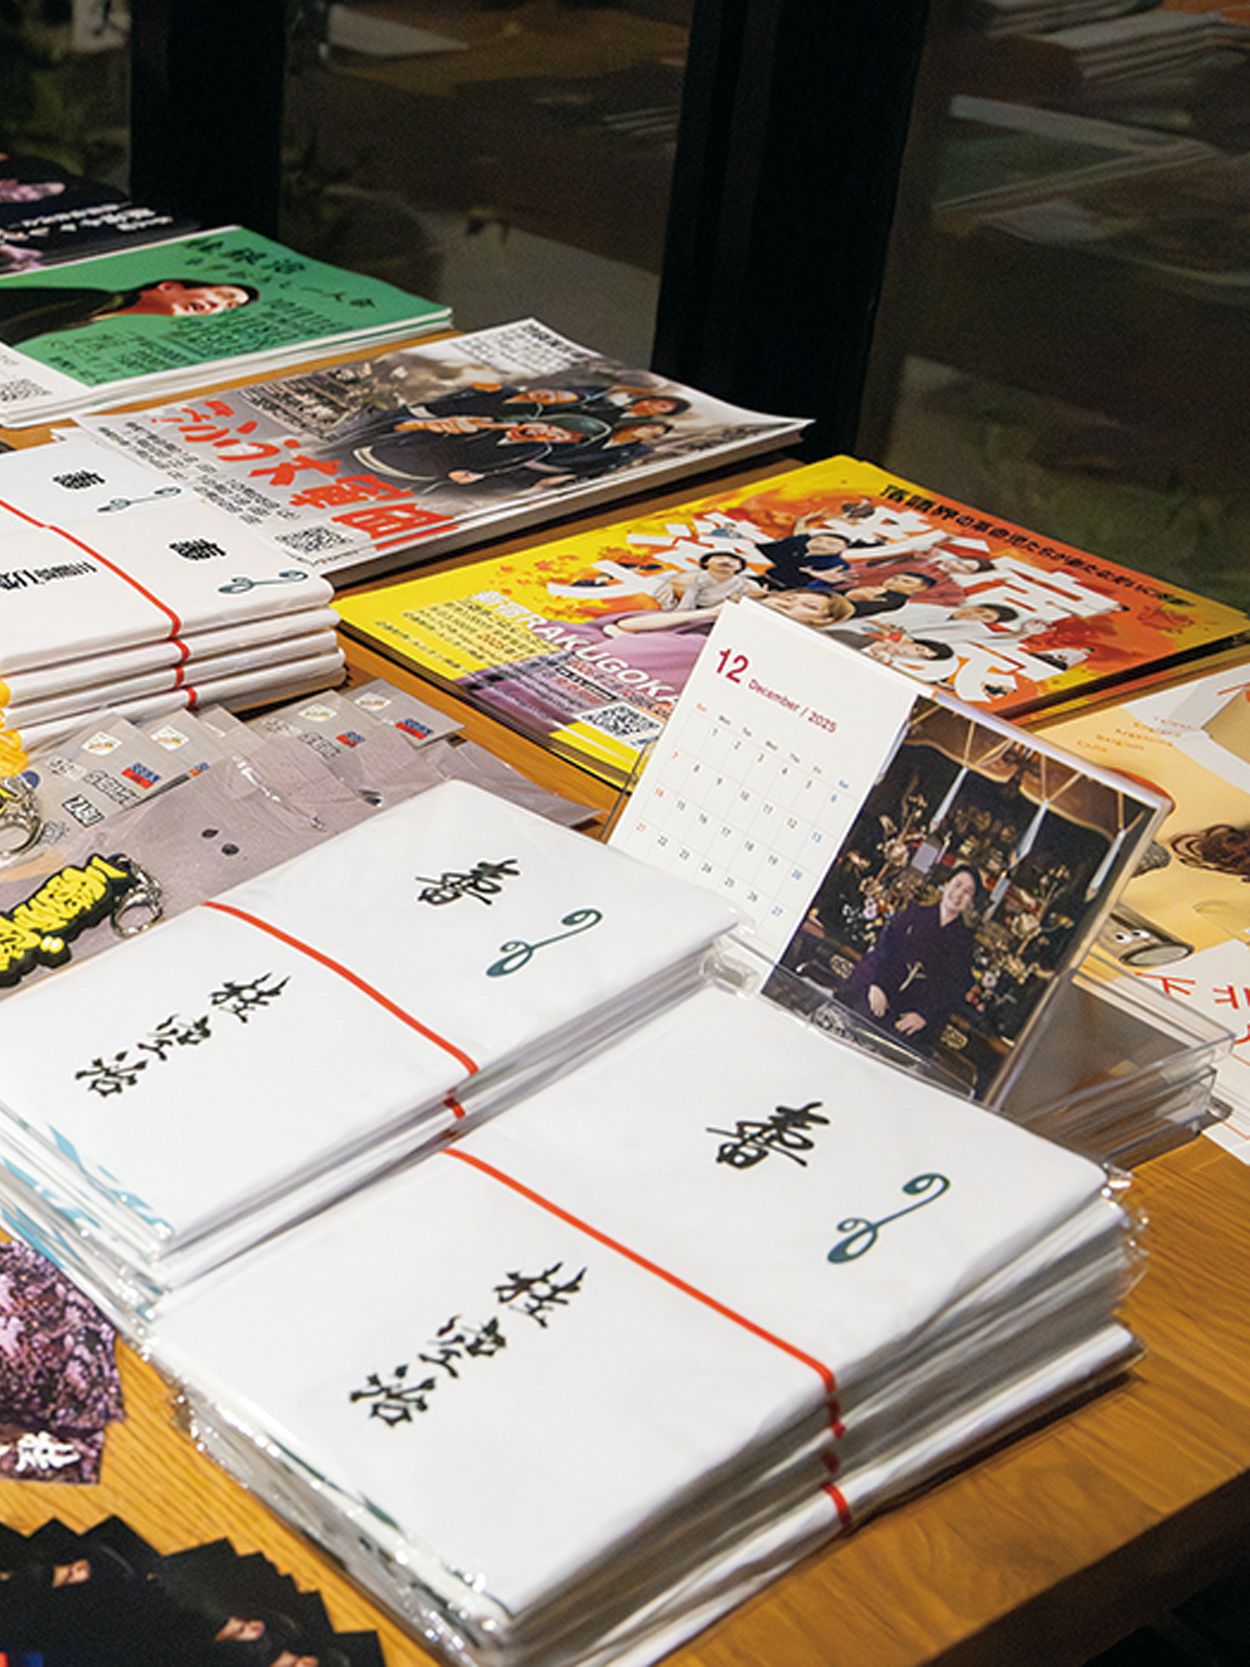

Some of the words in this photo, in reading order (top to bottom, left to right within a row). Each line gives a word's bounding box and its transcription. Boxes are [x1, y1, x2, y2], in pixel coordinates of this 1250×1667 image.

[716, 648, 750, 684] 12
[748, 678, 801, 714] December
[807, 711, 838, 734] 2025
[74, 970, 292, 1099] 桂空治
[348, 1260, 589, 1430] 桂空治
